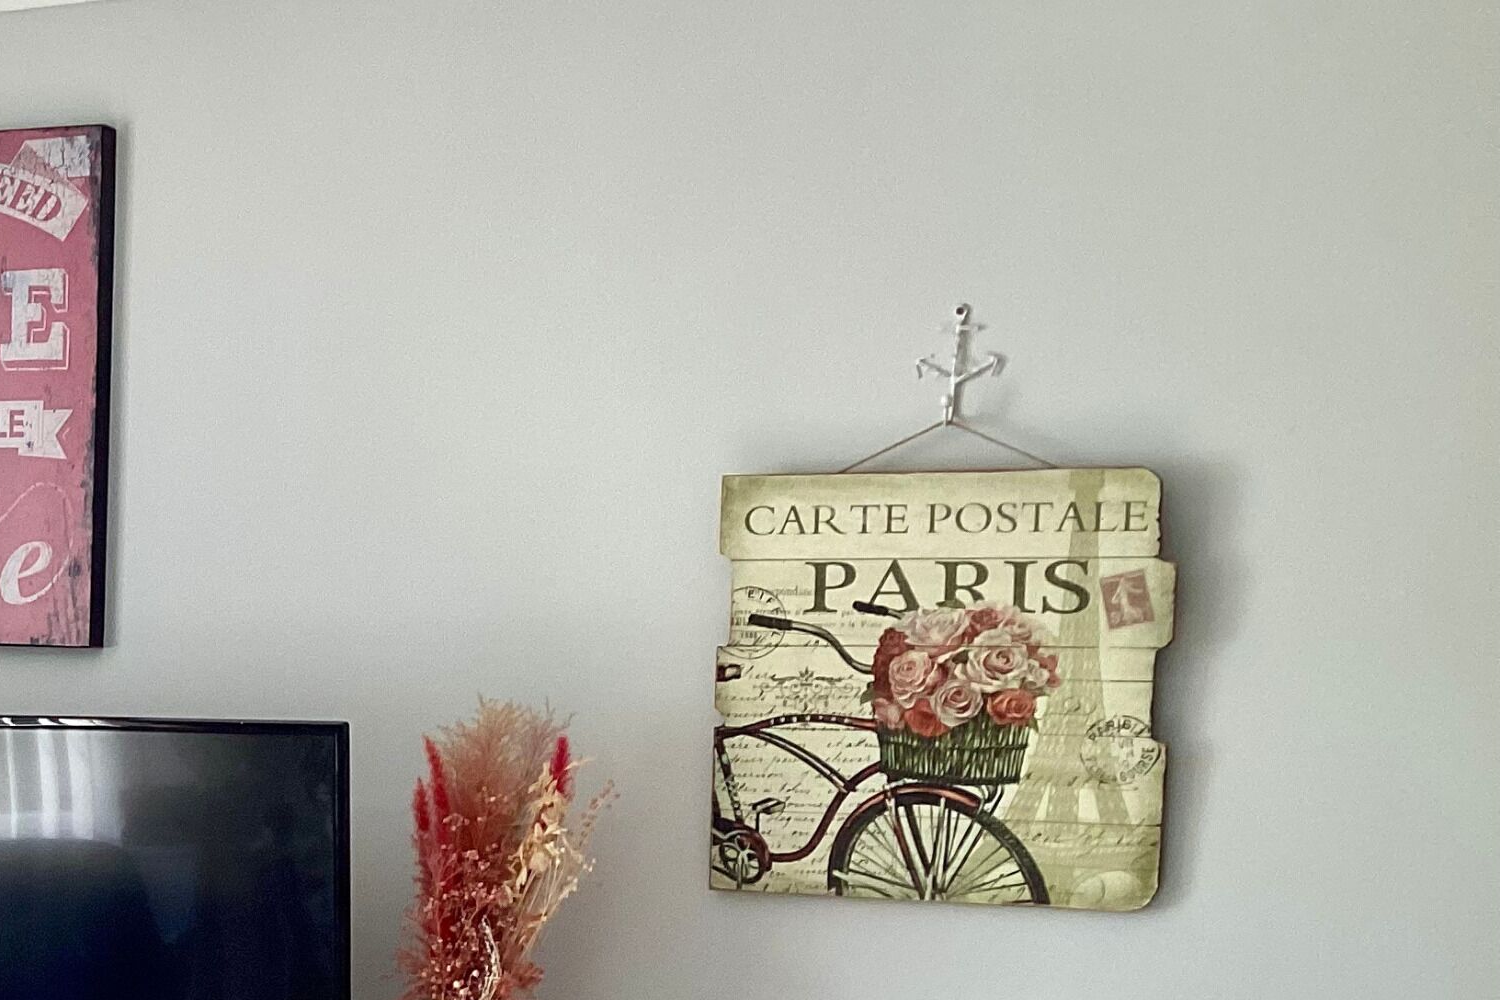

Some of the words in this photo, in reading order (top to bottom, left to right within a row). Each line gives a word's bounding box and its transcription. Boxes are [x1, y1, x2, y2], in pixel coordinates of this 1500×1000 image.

[744, 503, 909, 536] CARTE
[928, 501, 1149, 534] POSTALE
[802, 559, 1092, 615] PARIS
